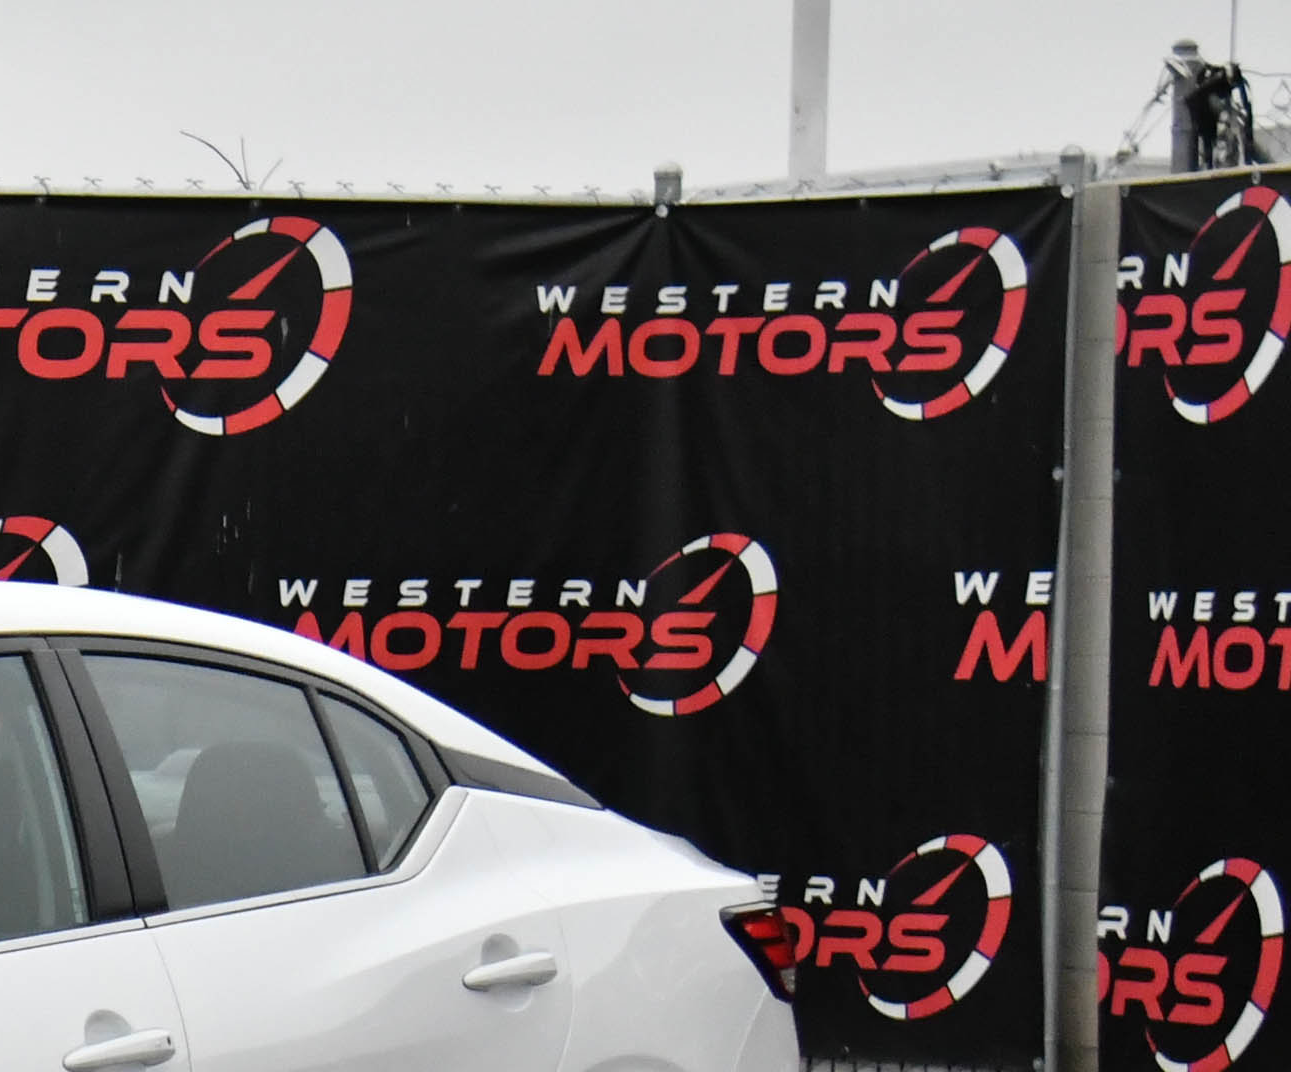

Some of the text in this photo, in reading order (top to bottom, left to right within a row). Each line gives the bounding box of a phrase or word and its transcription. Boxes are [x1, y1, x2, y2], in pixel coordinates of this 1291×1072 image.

[537, 280, 898, 313] WESTERN
[539, 311, 963, 378] MOTORS
[280, 580, 646, 607] WESTERN
